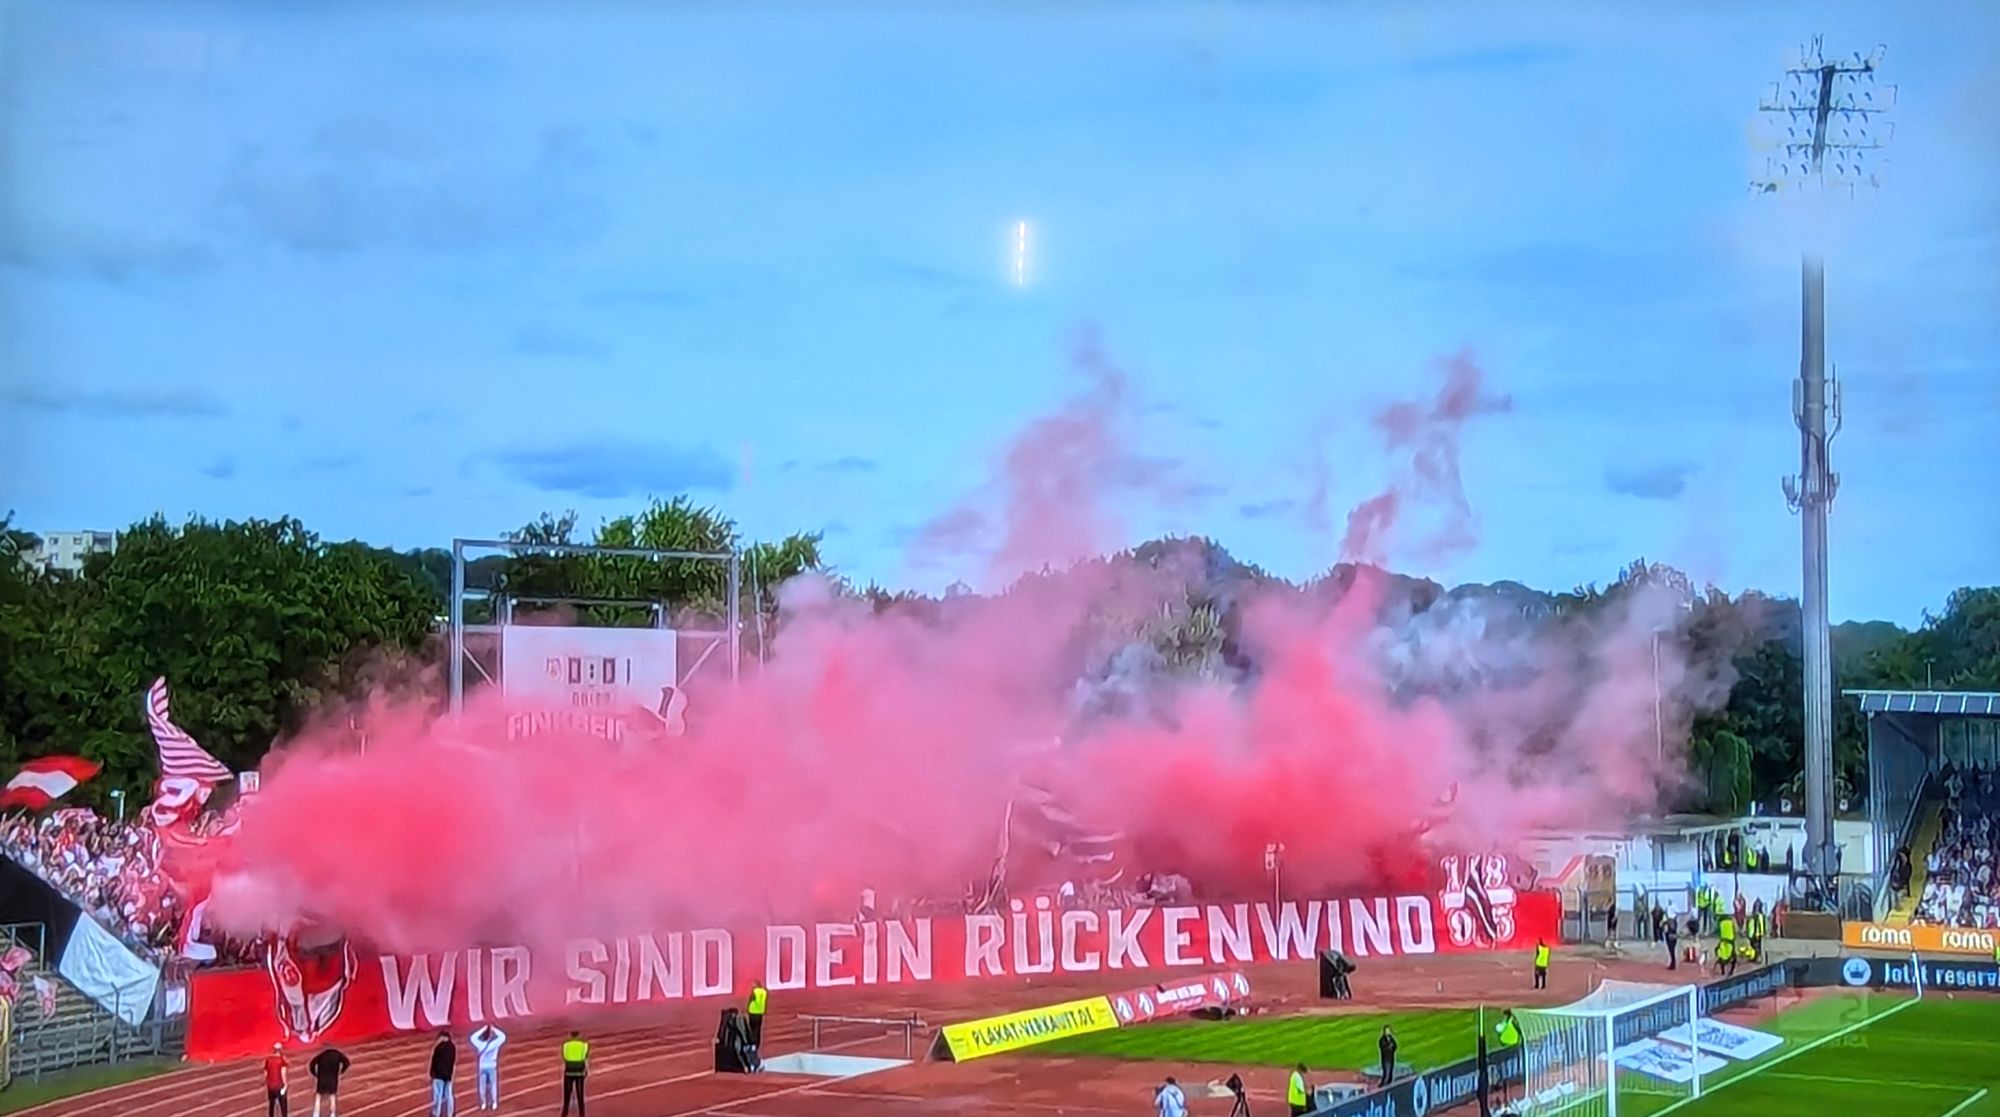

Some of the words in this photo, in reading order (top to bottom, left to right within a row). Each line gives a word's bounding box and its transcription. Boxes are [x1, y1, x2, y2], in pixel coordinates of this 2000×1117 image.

[1862, 926, 1911, 945] roma
[1942, 931, 1994, 950] roma
[379, 945, 533, 1029] WIR
[565, 928, 734, 1005] SIND
[766, 917, 932, 991] DEIN
[965, 896, 1435, 976] RÜCKENWIND
